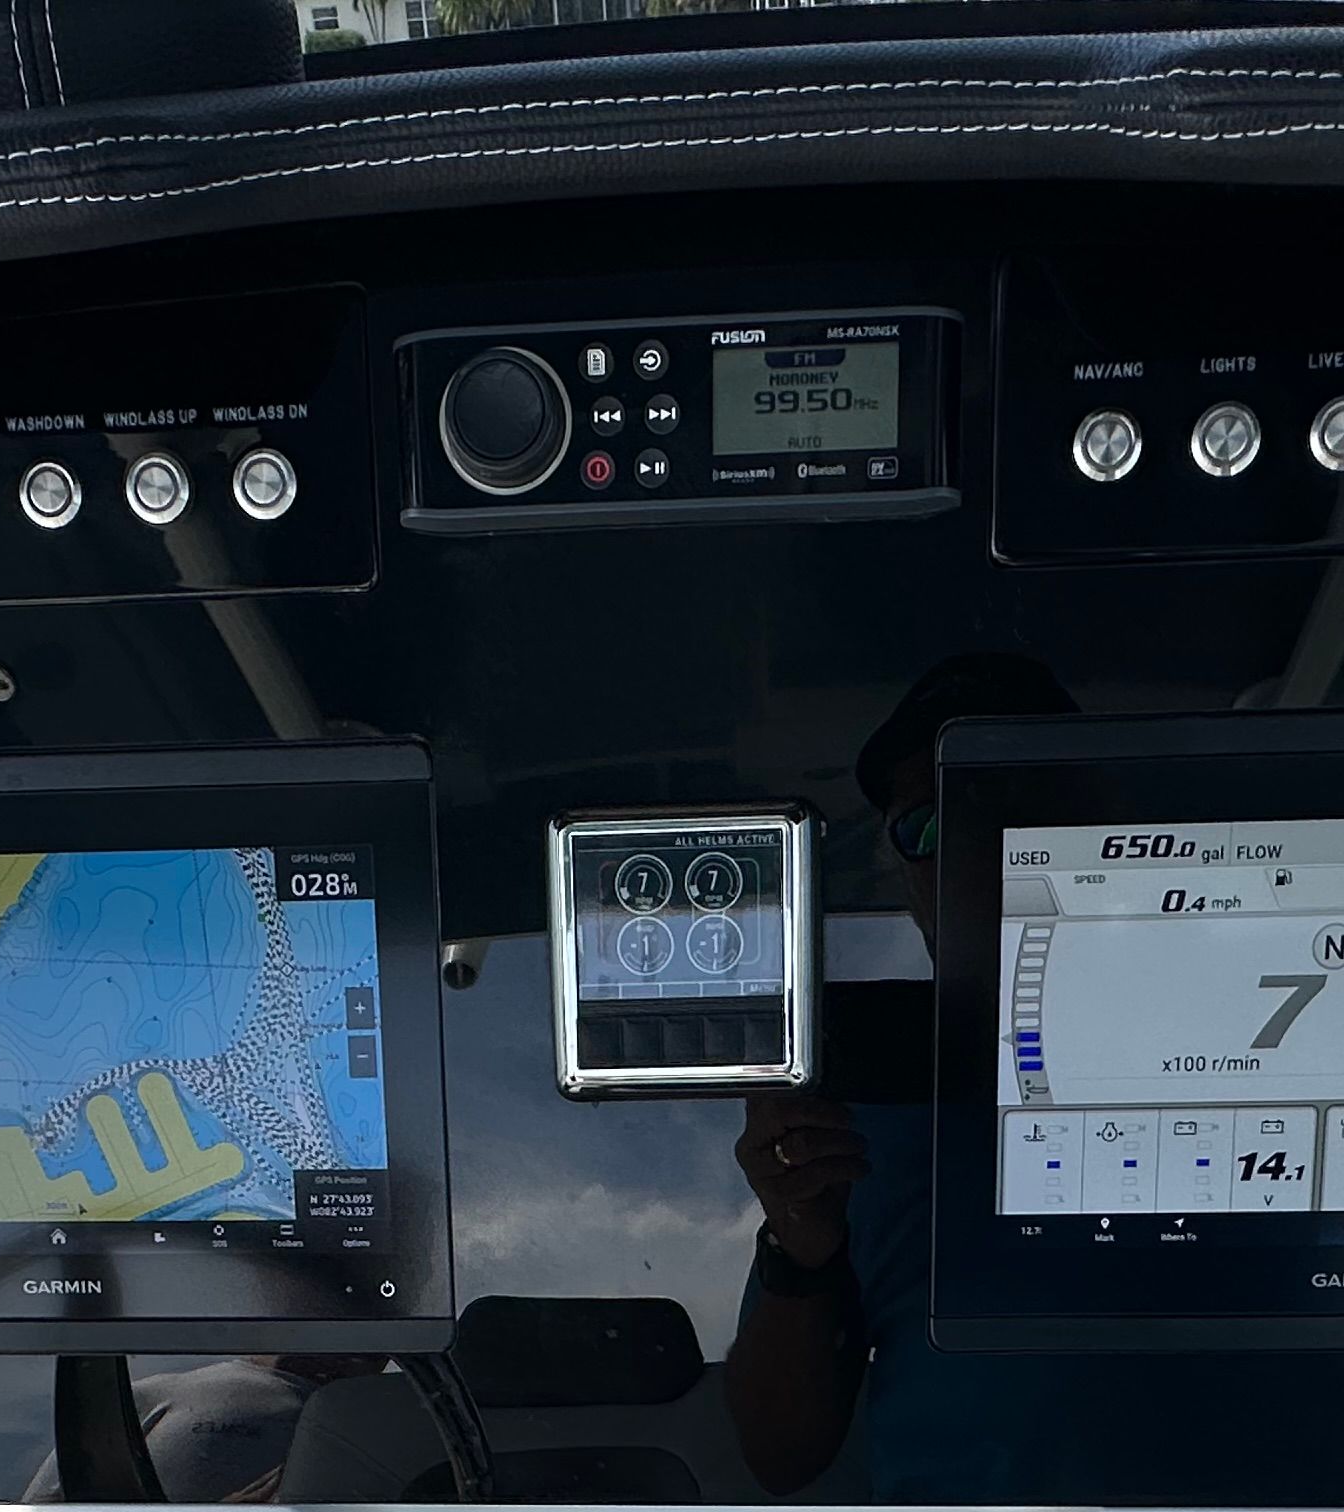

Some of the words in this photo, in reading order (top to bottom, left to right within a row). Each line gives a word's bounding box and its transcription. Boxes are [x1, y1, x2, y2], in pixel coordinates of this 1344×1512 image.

[711, 329, 766, 345] FUSION
[794, 352, 816, 365] FM
[1200, 356, 1256, 374] LIGHTS
[1073, 361, 1143, 380] NAV/ANC
[754, 388, 853, 414] 99.50
[104, 408, 175, 428] WINDLASS
[179, 408, 198, 424] UP
[212, 404, 285, 422] WINDLASS
[5, 414, 85, 432] WASHDOWN
[788, 437, 822, 448] AUTO
[674, 836, 694, 847] ALL
[697, 835, 734, 846] HELMS
[736, 834, 775, 845] ACTIVE
[1009, 851, 1051, 866] USED
[1100, 834, 1197, 860] 650.0
[1201, 847, 1225, 865] gal
[1235, 844, 1284, 860] FLOW
[638, 872, 648, 893] 7
[707, 870, 719, 891] 7
[1073, 873, 1106, 885] SPEED
[1160, 889, 1206, 913] 0.4
[1211, 895, 1242, 910] mph
[1249, 974, 1329, 1050] 7
[1162, 1055, 1206, 1073] x100
[1211, 1054, 1261, 1073] r/min
[1237, 1150, 1306, 1182] 14.1
[1264, 1195, 1274, 1206] V
[23, 1280, 103, 1294] GARMIN
